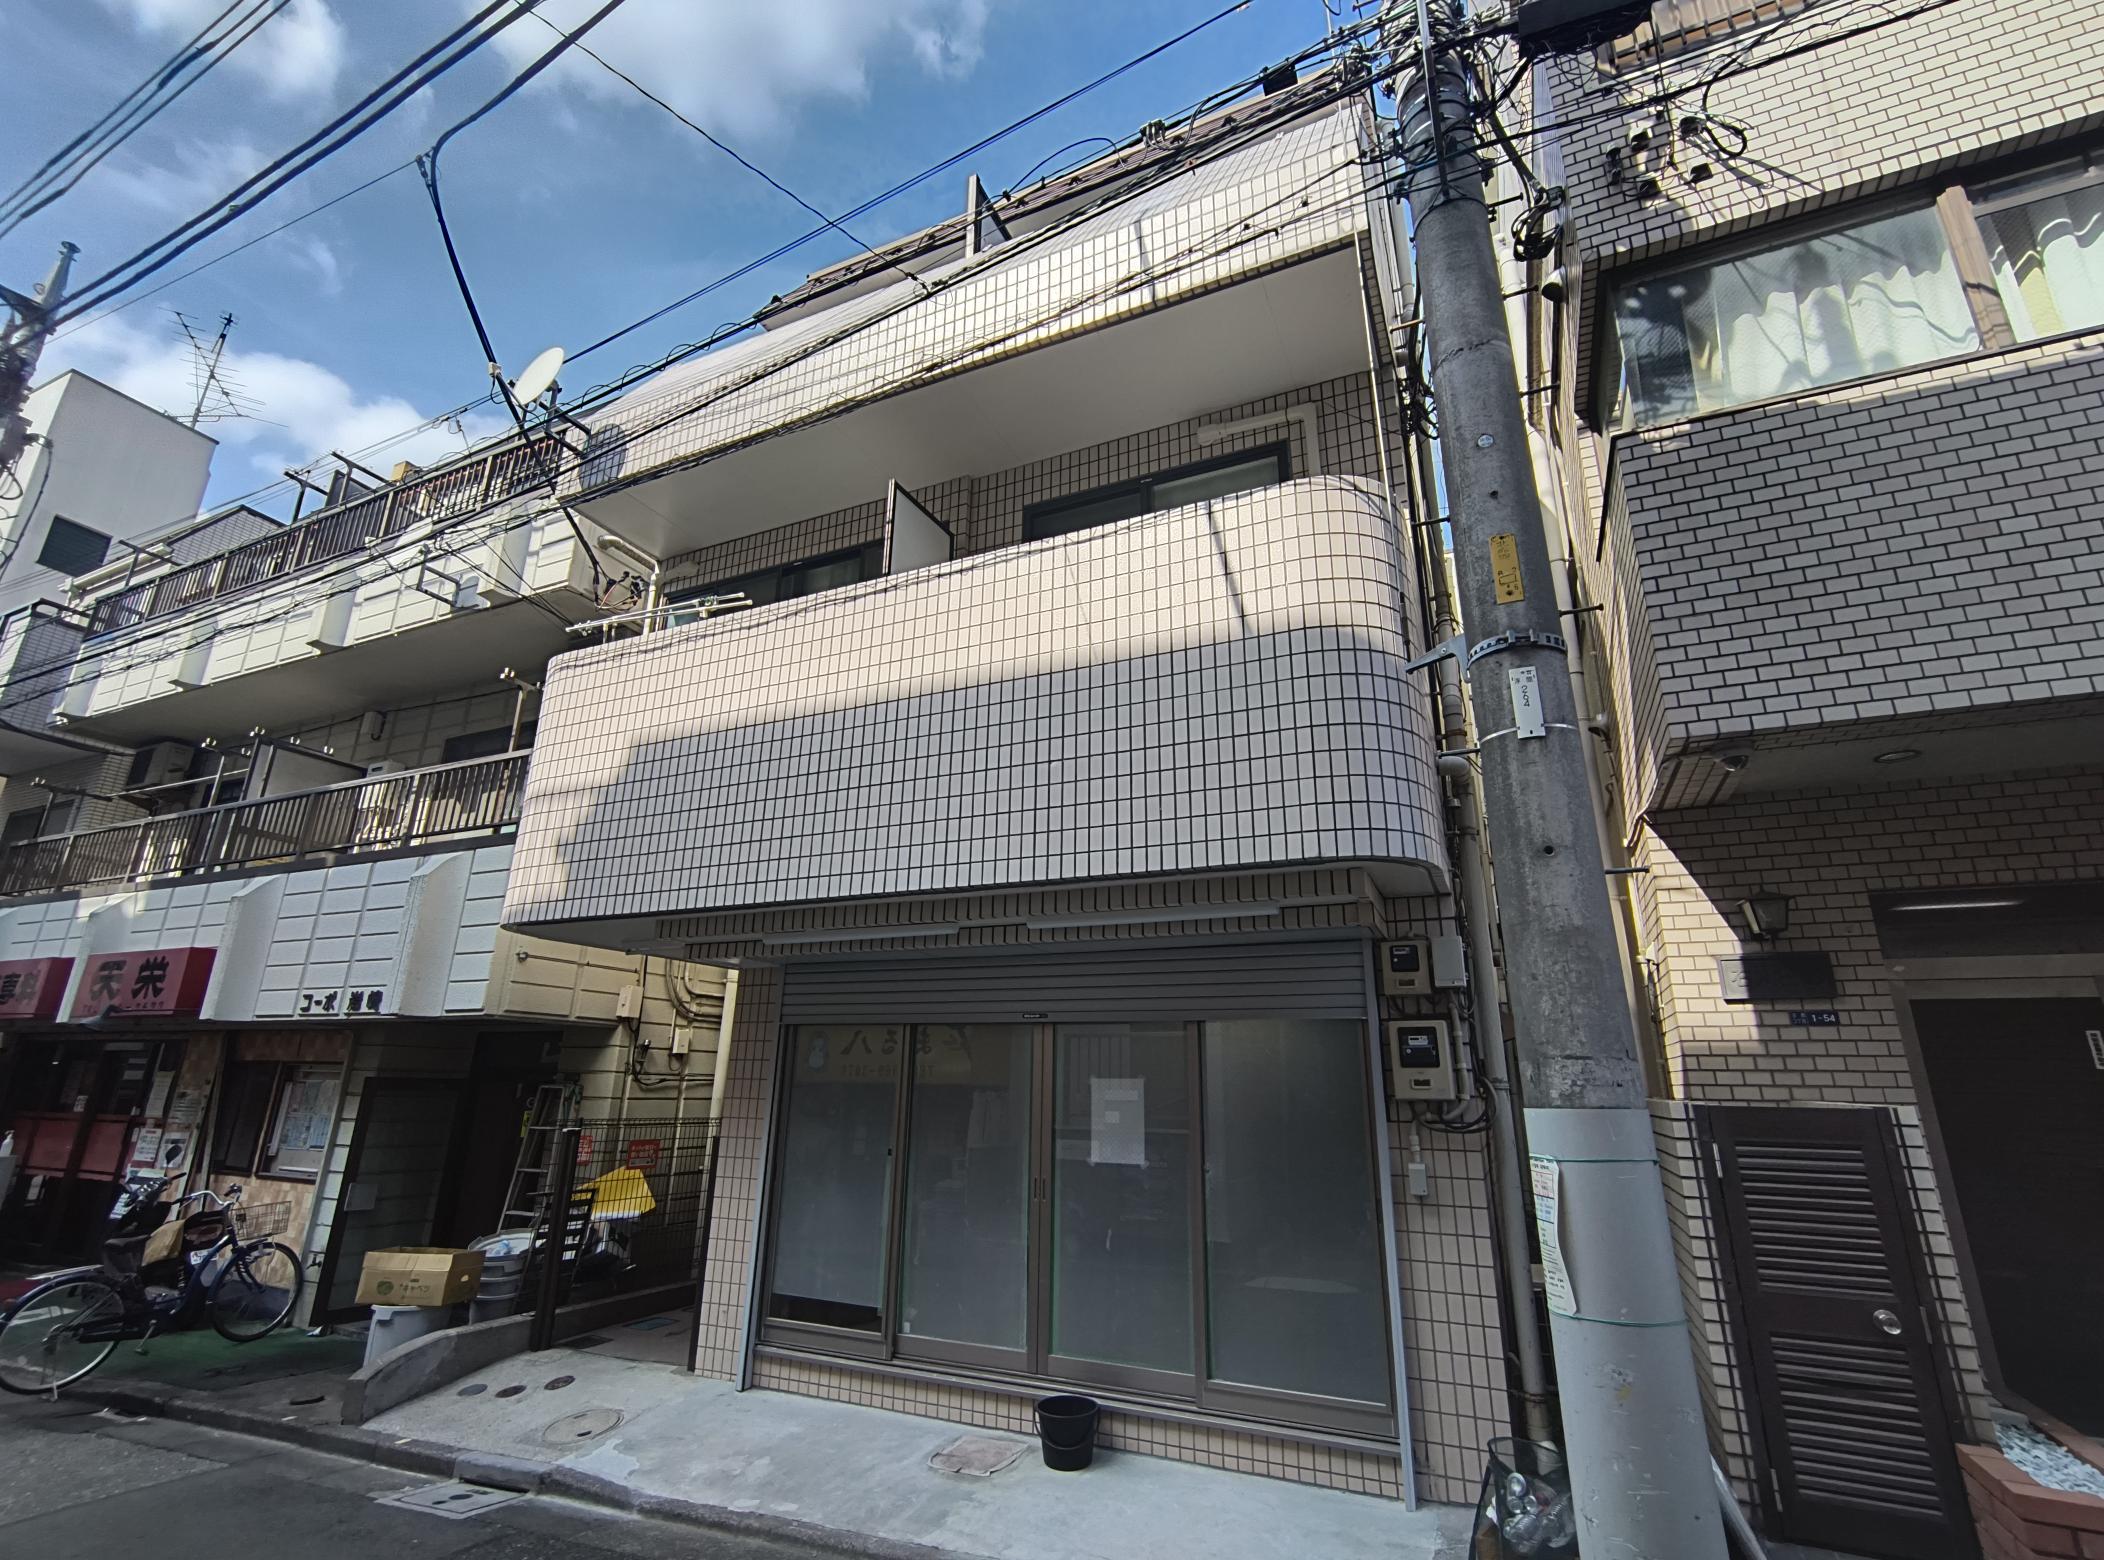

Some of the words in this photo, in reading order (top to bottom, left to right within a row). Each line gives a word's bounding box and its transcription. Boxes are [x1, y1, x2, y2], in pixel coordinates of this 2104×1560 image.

[90, 955, 170, 1000] 天栄
[300, 991, 338, 1012] コーポ
[1811, 1014, 1836, 1023] 1-54
